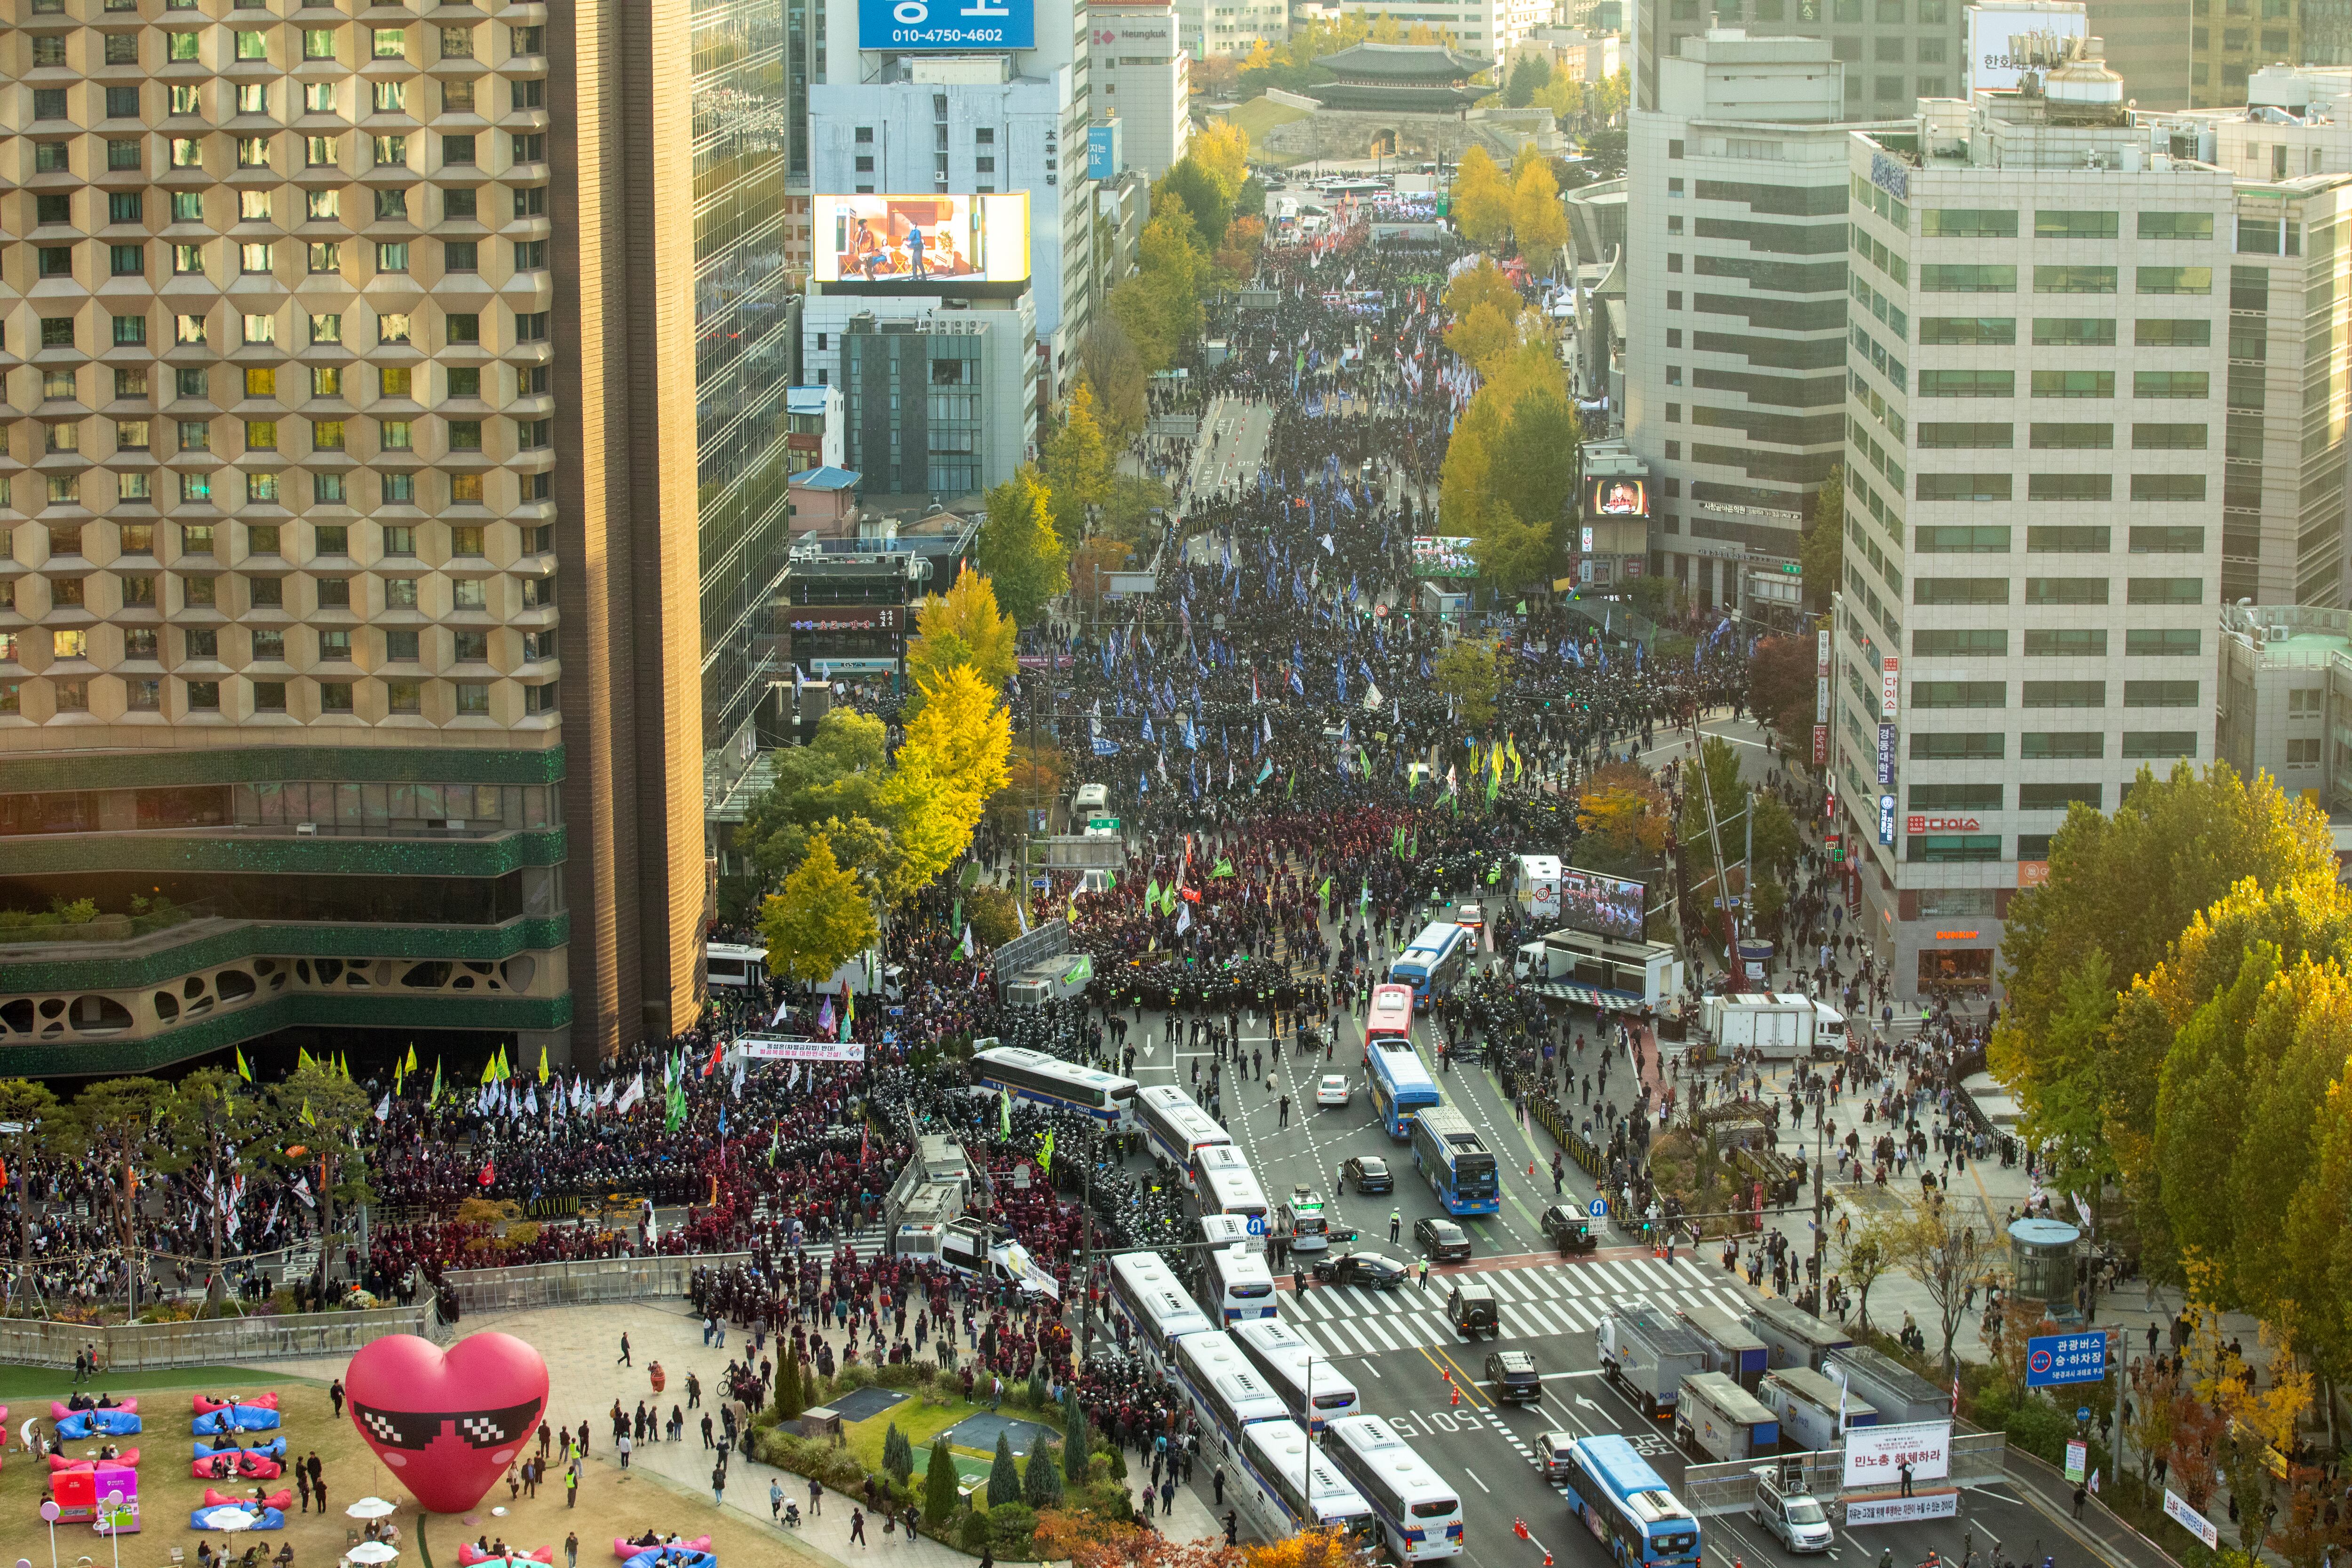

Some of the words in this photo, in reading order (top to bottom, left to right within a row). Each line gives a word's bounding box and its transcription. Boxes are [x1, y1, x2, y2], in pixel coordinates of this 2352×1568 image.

[893, 30, 1002, 41] 010-4750-4602
[1122, 30, 1166, 39] Heungkuk
[1046, 130, 1056, 184] 太平빌딩
[1089, 154, 1101, 165] lk
[1884, 677, 1897, 709] 다이소
[1878, 729, 1889, 783] 경동대학교
[1930, 818, 1980, 831] 다이소
[1076, 1106, 1090, 1114] POLICE
[2058, 1338, 2100, 1352] 관광버스
[2055, 1351, 2101, 1367] 승·하차장
[2052, 1370, 2075, 1379] 5분경과시
[1660, 1391, 1678, 1400] POLI
[1624, 1434, 1675, 1456] 공로
[1855, 1454, 1890, 1467] 민노총
[1895, 1449, 1941, 1464] 해체하라
[1249, 1465, 1257, 1479] POLICE
[1849, 1509, 1861, 1520] 자유는
[1862, 1508, 1875, 1519] 그것을
[1876, 1507, 1884, 1517] 위해
[1885, 1505, 1902, 1516] 투쟁하는
[1903, 1504, 1915, 1514] 자만이
[1916, 1503, 1925, 1513] 누릴
[1926, 1503, 1931, 1511] 수
[1931, 1501, 1939, 1512] 있는
[1941, 1500, 1953, 1511] 것이다
